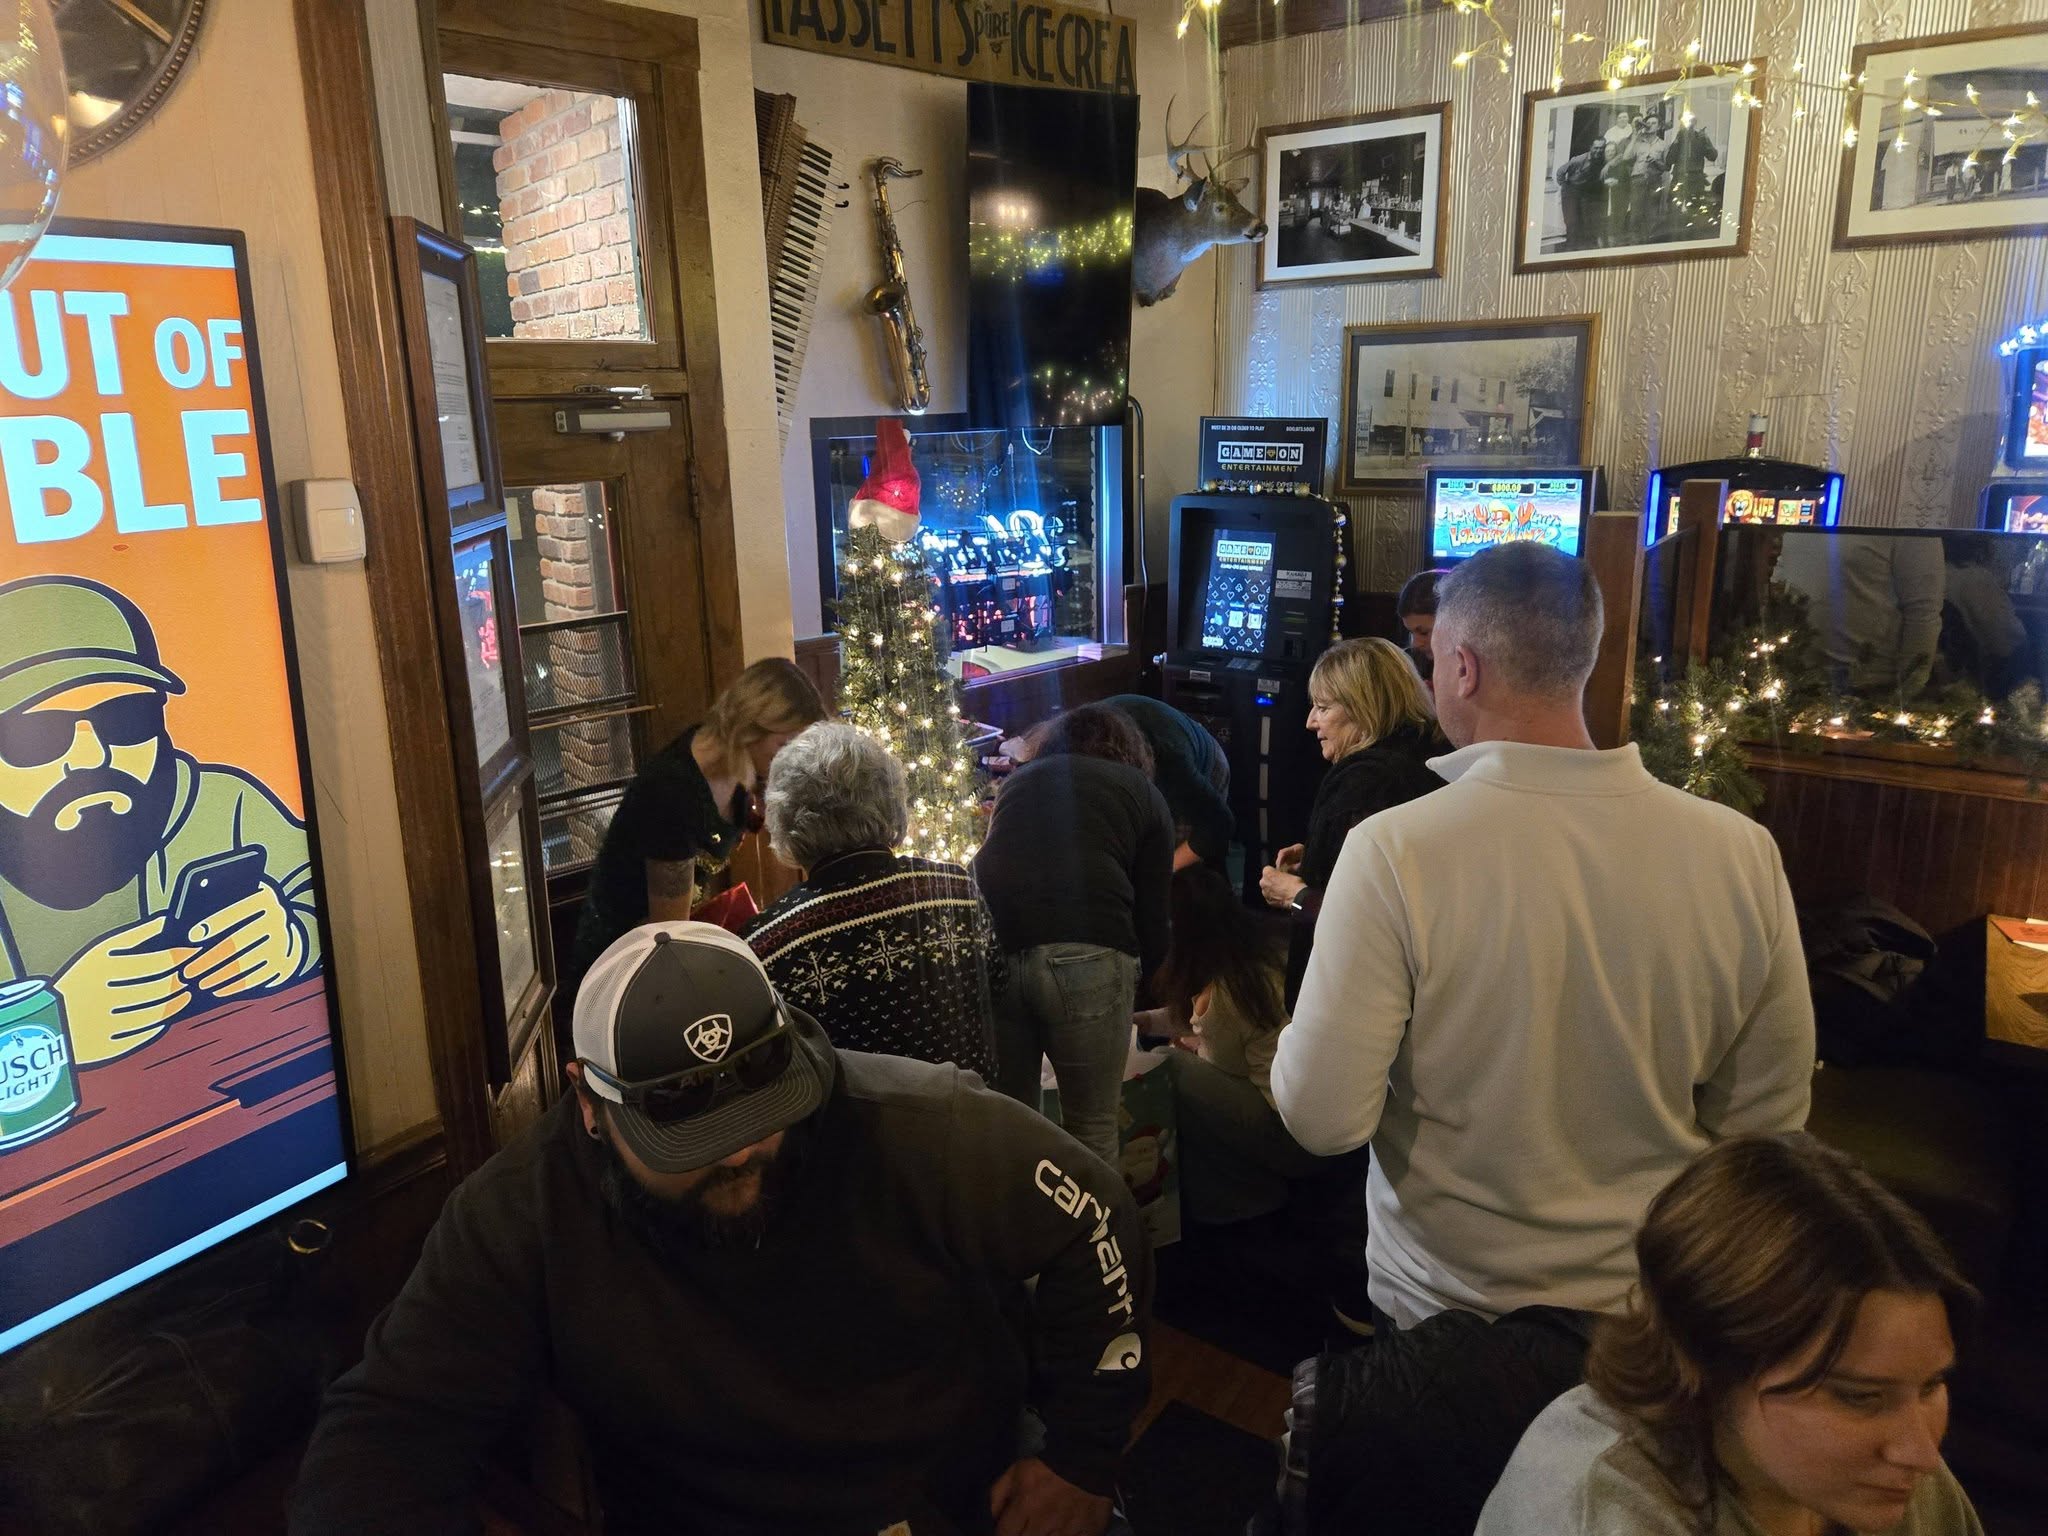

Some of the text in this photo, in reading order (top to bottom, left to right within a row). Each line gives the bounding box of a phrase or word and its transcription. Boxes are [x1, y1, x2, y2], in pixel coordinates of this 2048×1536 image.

[154, 317, 243, 389] OF
[1221, 446, 1300, 460] GAME ON
[1221, 463, 1298, 473] ENTERTAINMENT
[0, 1071, 52, 1100] IGHT
